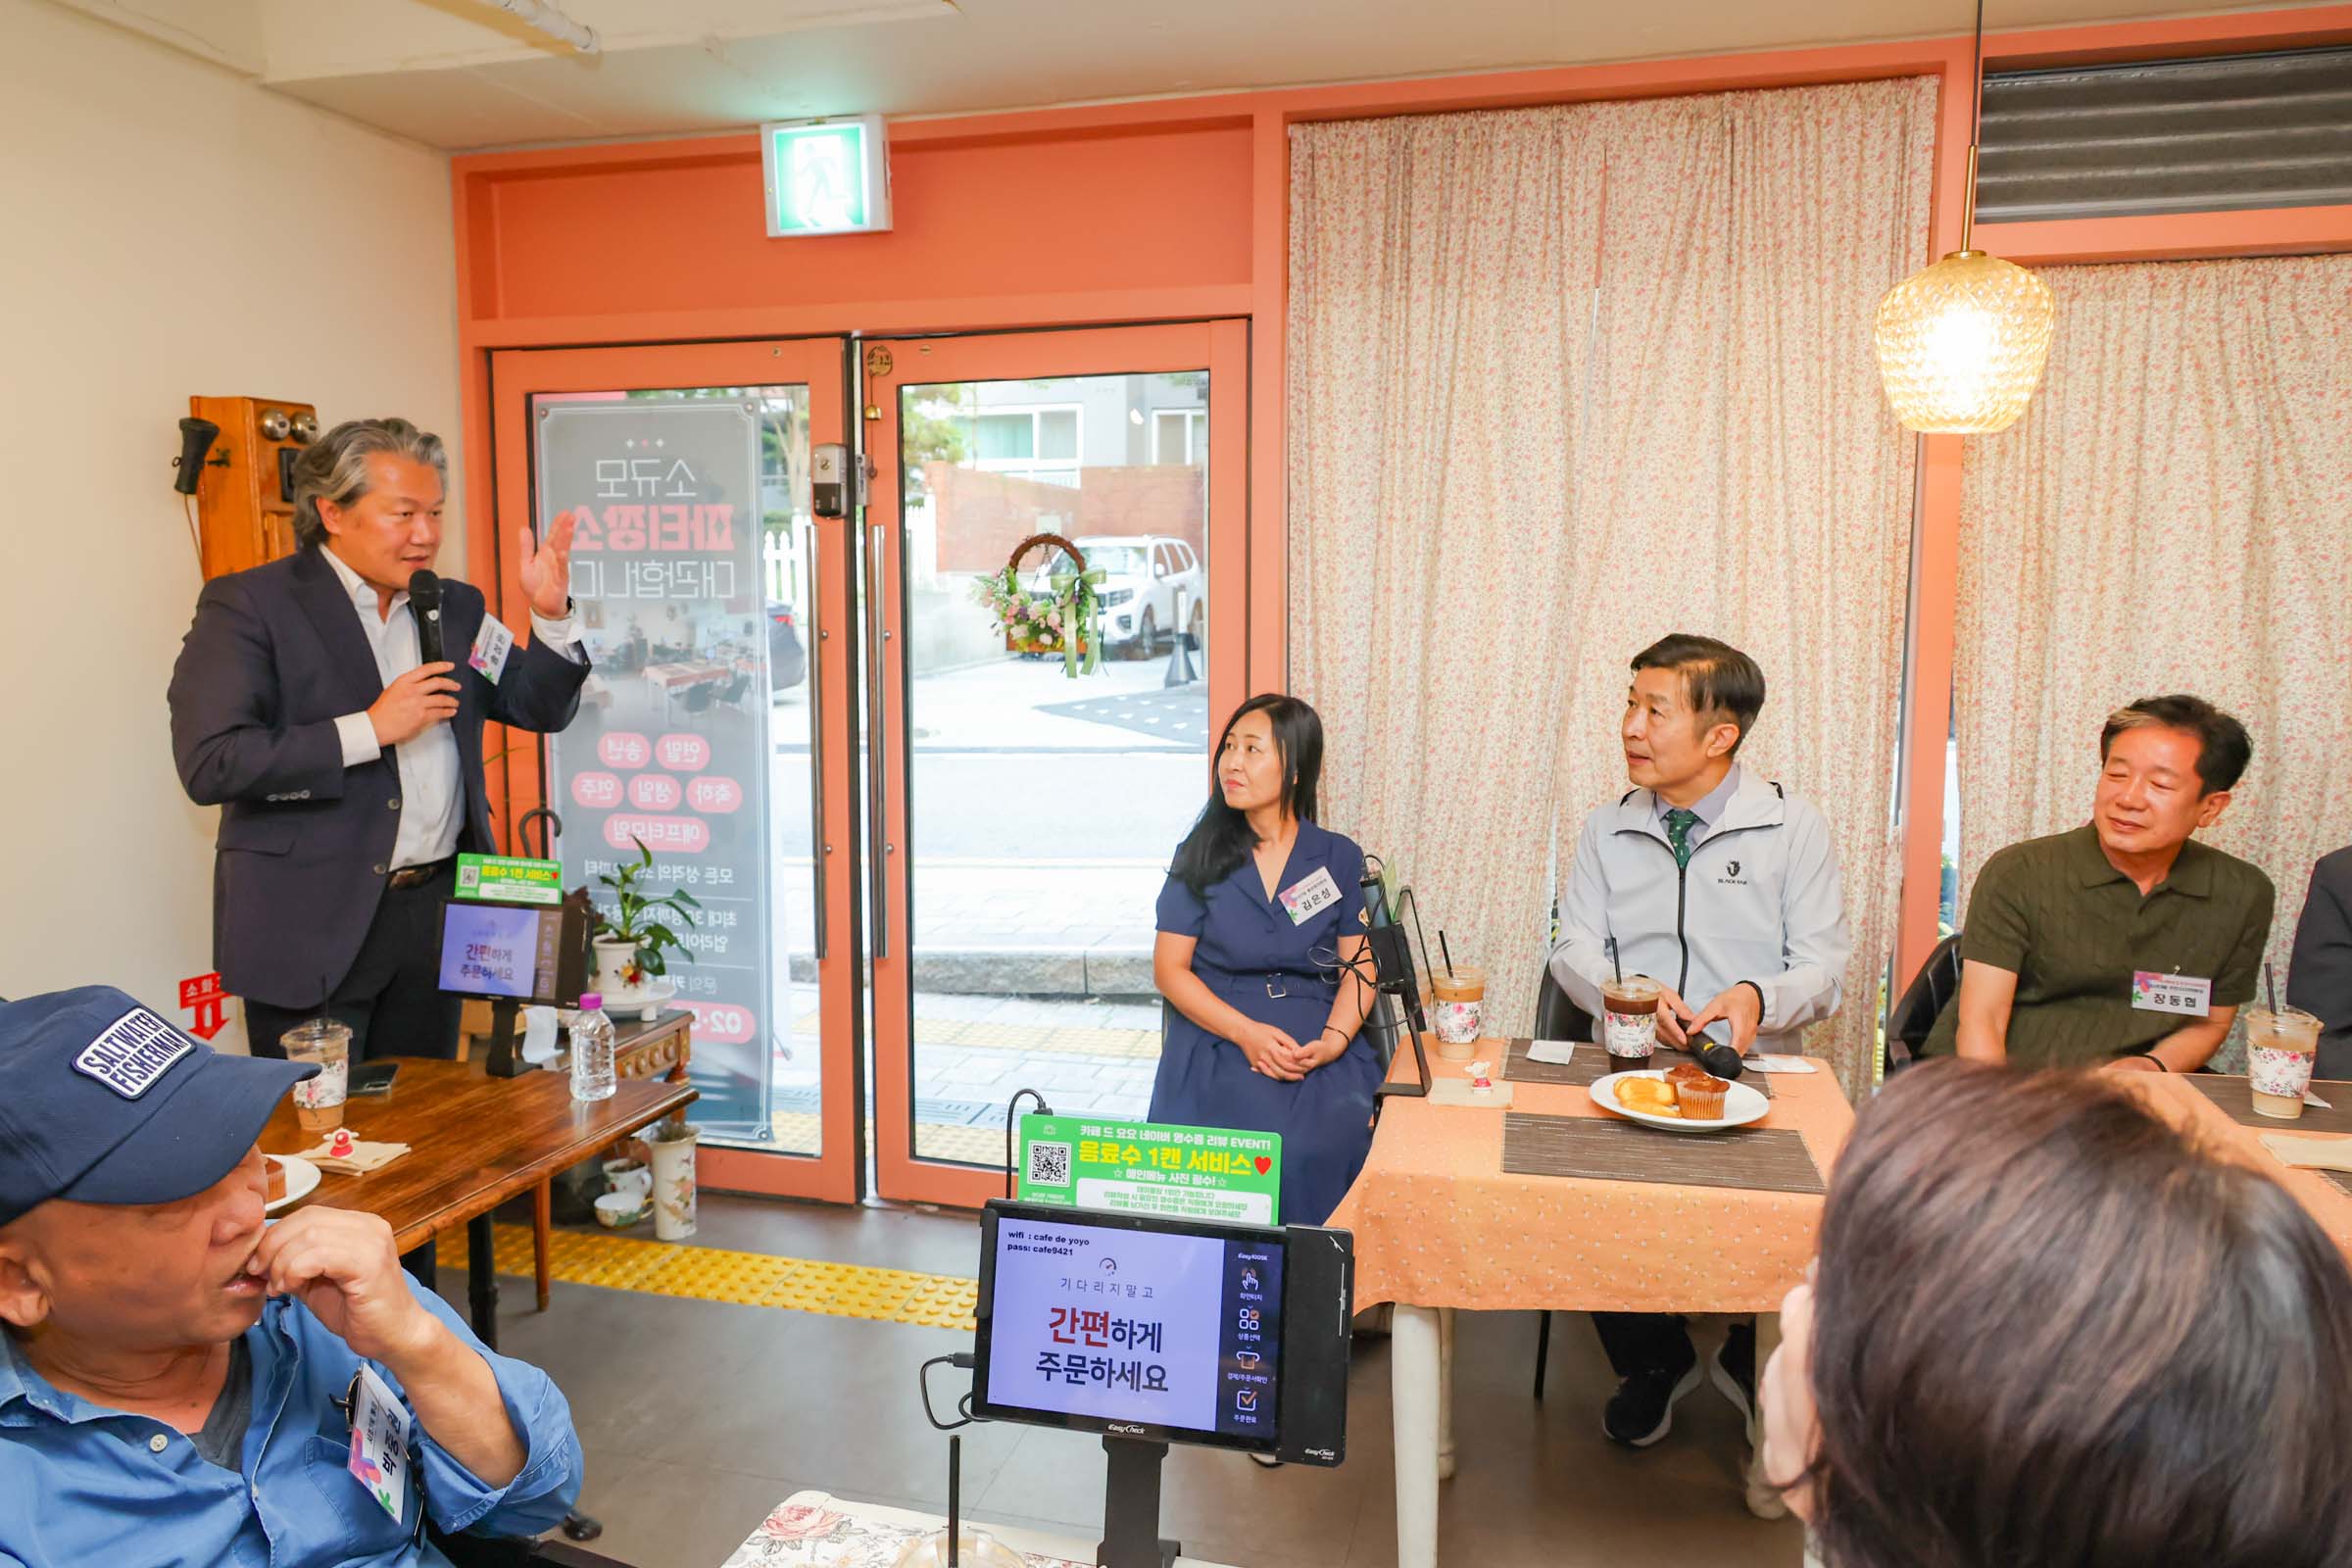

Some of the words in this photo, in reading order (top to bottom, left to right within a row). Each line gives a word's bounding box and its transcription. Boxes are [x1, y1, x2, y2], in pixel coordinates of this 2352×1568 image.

[1301, 887, 1331, 911] 김은성
[186, 976, 220, 998] 소화
[83, 1012, 165, 1075] SALTWATER
[110, 1029, 189, 1093] FISHERMAN
[1079, 1141, 1142, 1166] 음료수
[1149, 1147, 1181, 1169] 1캔
[1187, 1150, 1252, 1176] 서비스
[1231, 1137, 1271, 1151] EVENT!
[1007, 1244, 1031, 1252] pass:
[1033, 1246, 1073, 1256] cafe9421
[1008, 1231, 1024, 1240] wifi
[1034, 1233, 1054, 1243] cafe
[1055, 1235, 1066, 1244] de
[1068, 1238, 1090, 1247] yoyo
[1049, 1307, 1162, 1353] 간편하게
[1036, 1351, 1168, 1393] 주문하세요
